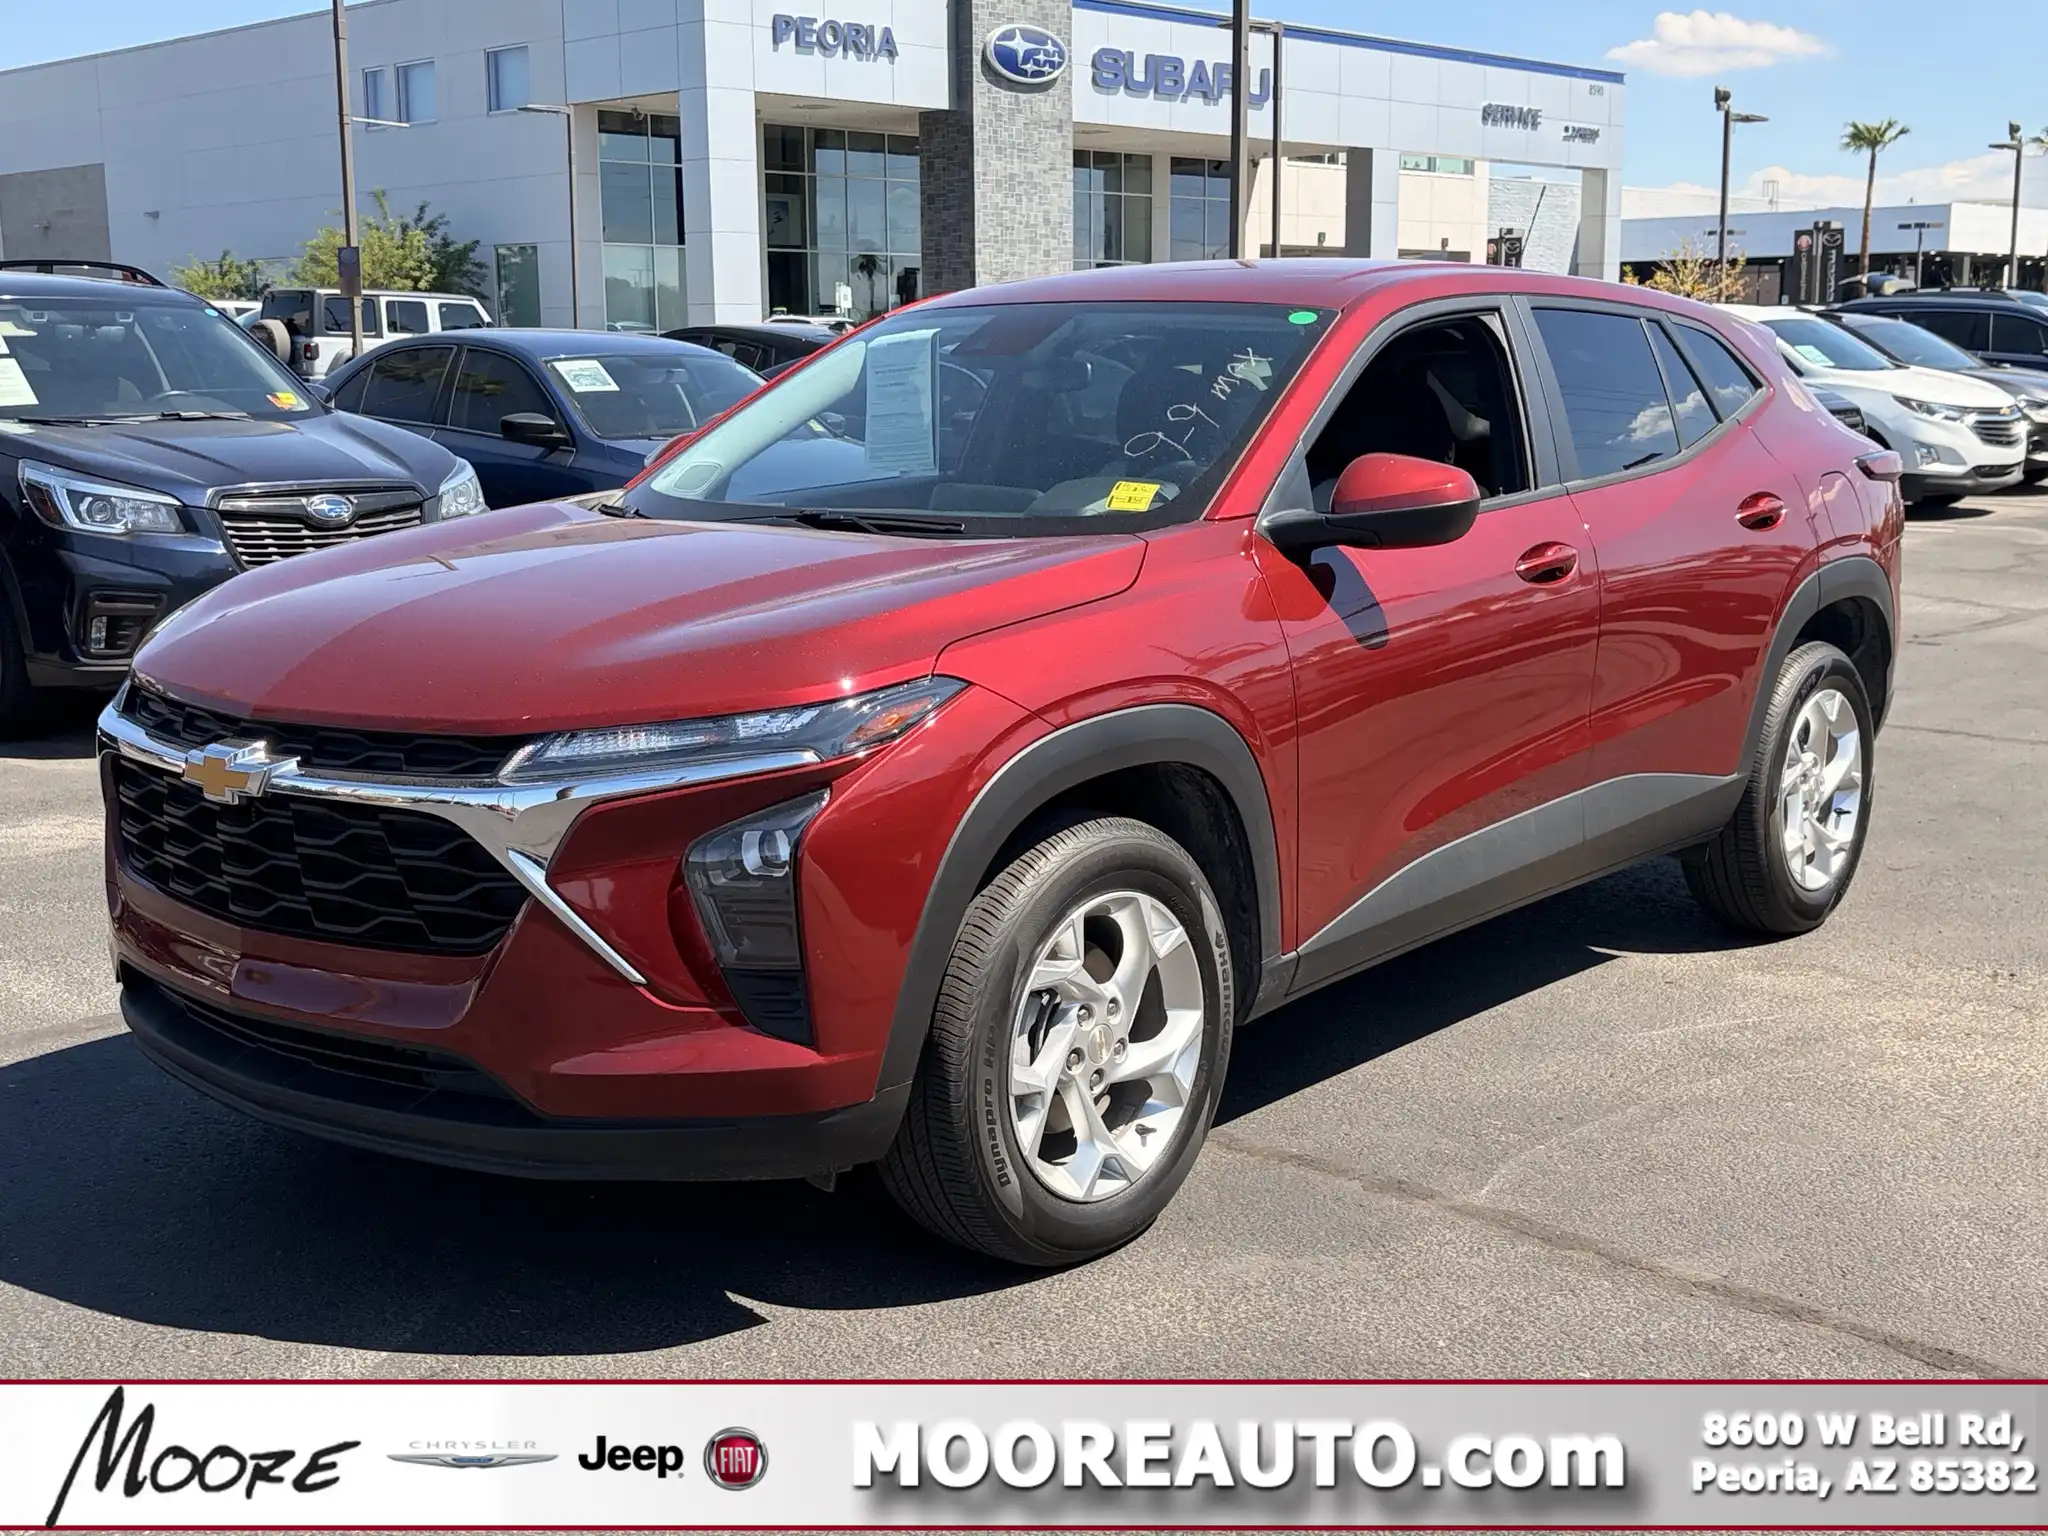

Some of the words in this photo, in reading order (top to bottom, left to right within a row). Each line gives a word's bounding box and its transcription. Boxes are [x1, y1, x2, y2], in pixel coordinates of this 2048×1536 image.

[772, 13, 899, 58] PEORIA
[1092, 47, 1271, 104] SUBARU
[1482, 103, 1542, 127] SERVICE
[984, 1078, 1012, 1188] Dynapro
